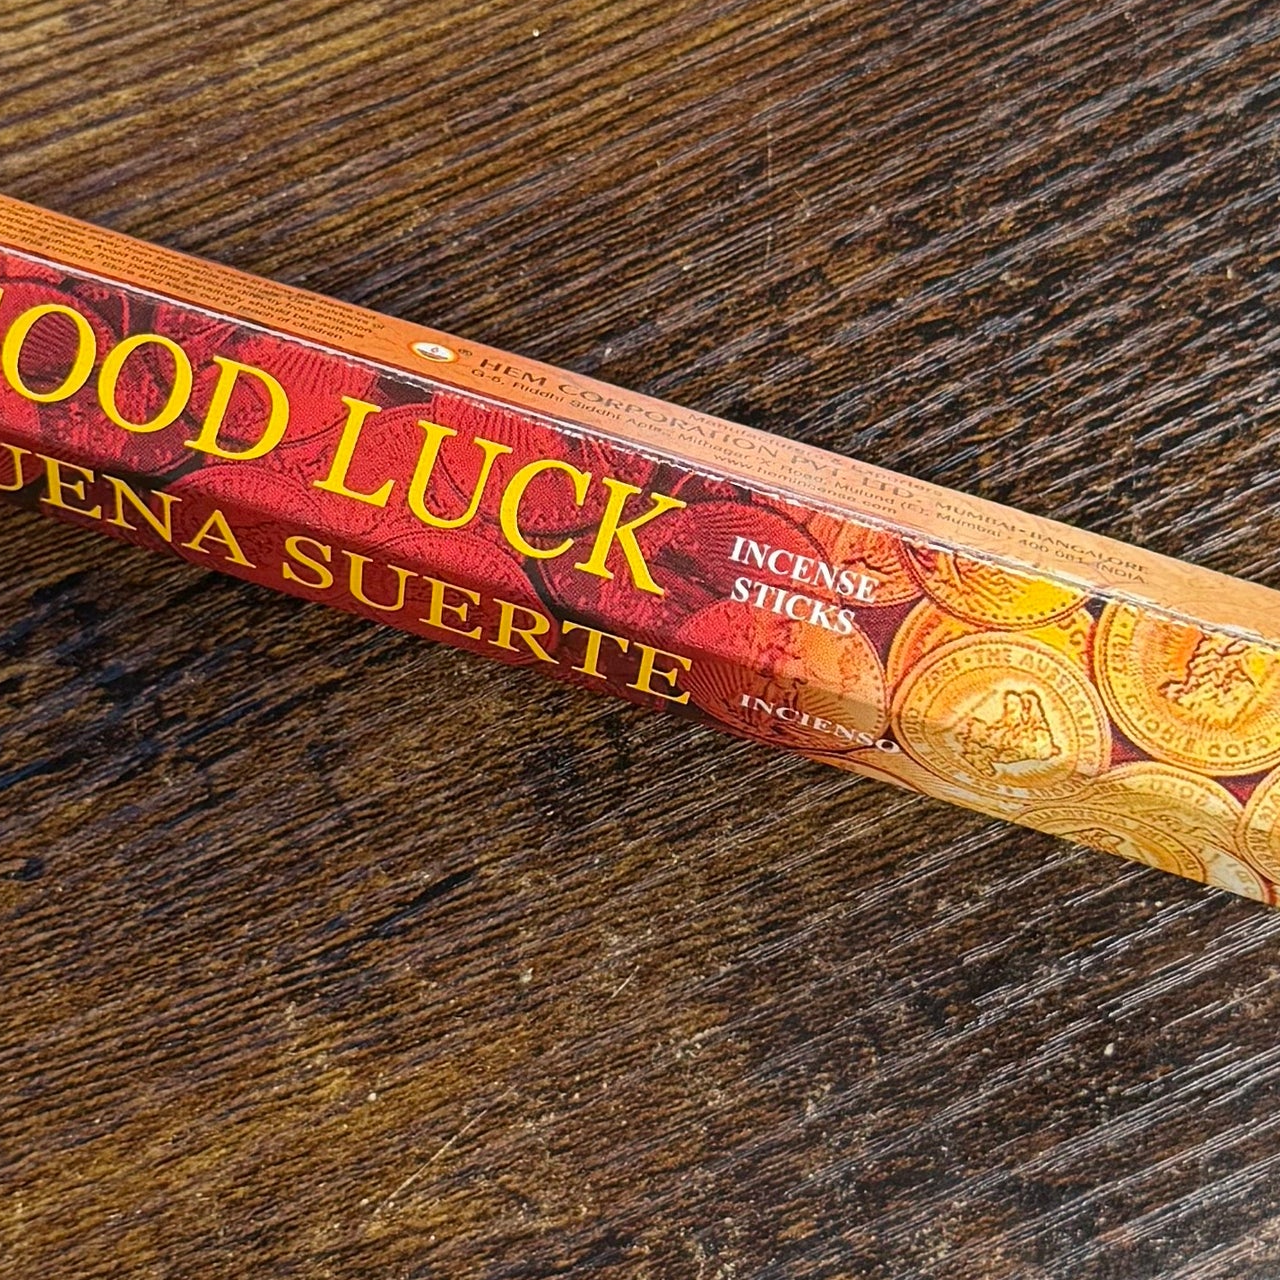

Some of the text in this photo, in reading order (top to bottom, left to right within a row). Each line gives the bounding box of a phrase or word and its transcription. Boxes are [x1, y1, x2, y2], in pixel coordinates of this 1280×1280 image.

[478, 357, 548, 386] HEM
[555, 381, 779, 459] CORPORATION
[512, 381, 564, 402] Riddhi
[833, 480, 895, 506] Mulund
[314, 395, 688, 597] LUCK
[281, 535, 691, 707] SUERTE
[729, 535, 881, 605] INCENSE
[730, 576, 856, 637] STICKS
[739, 692, 902, 755] INCIENSO
